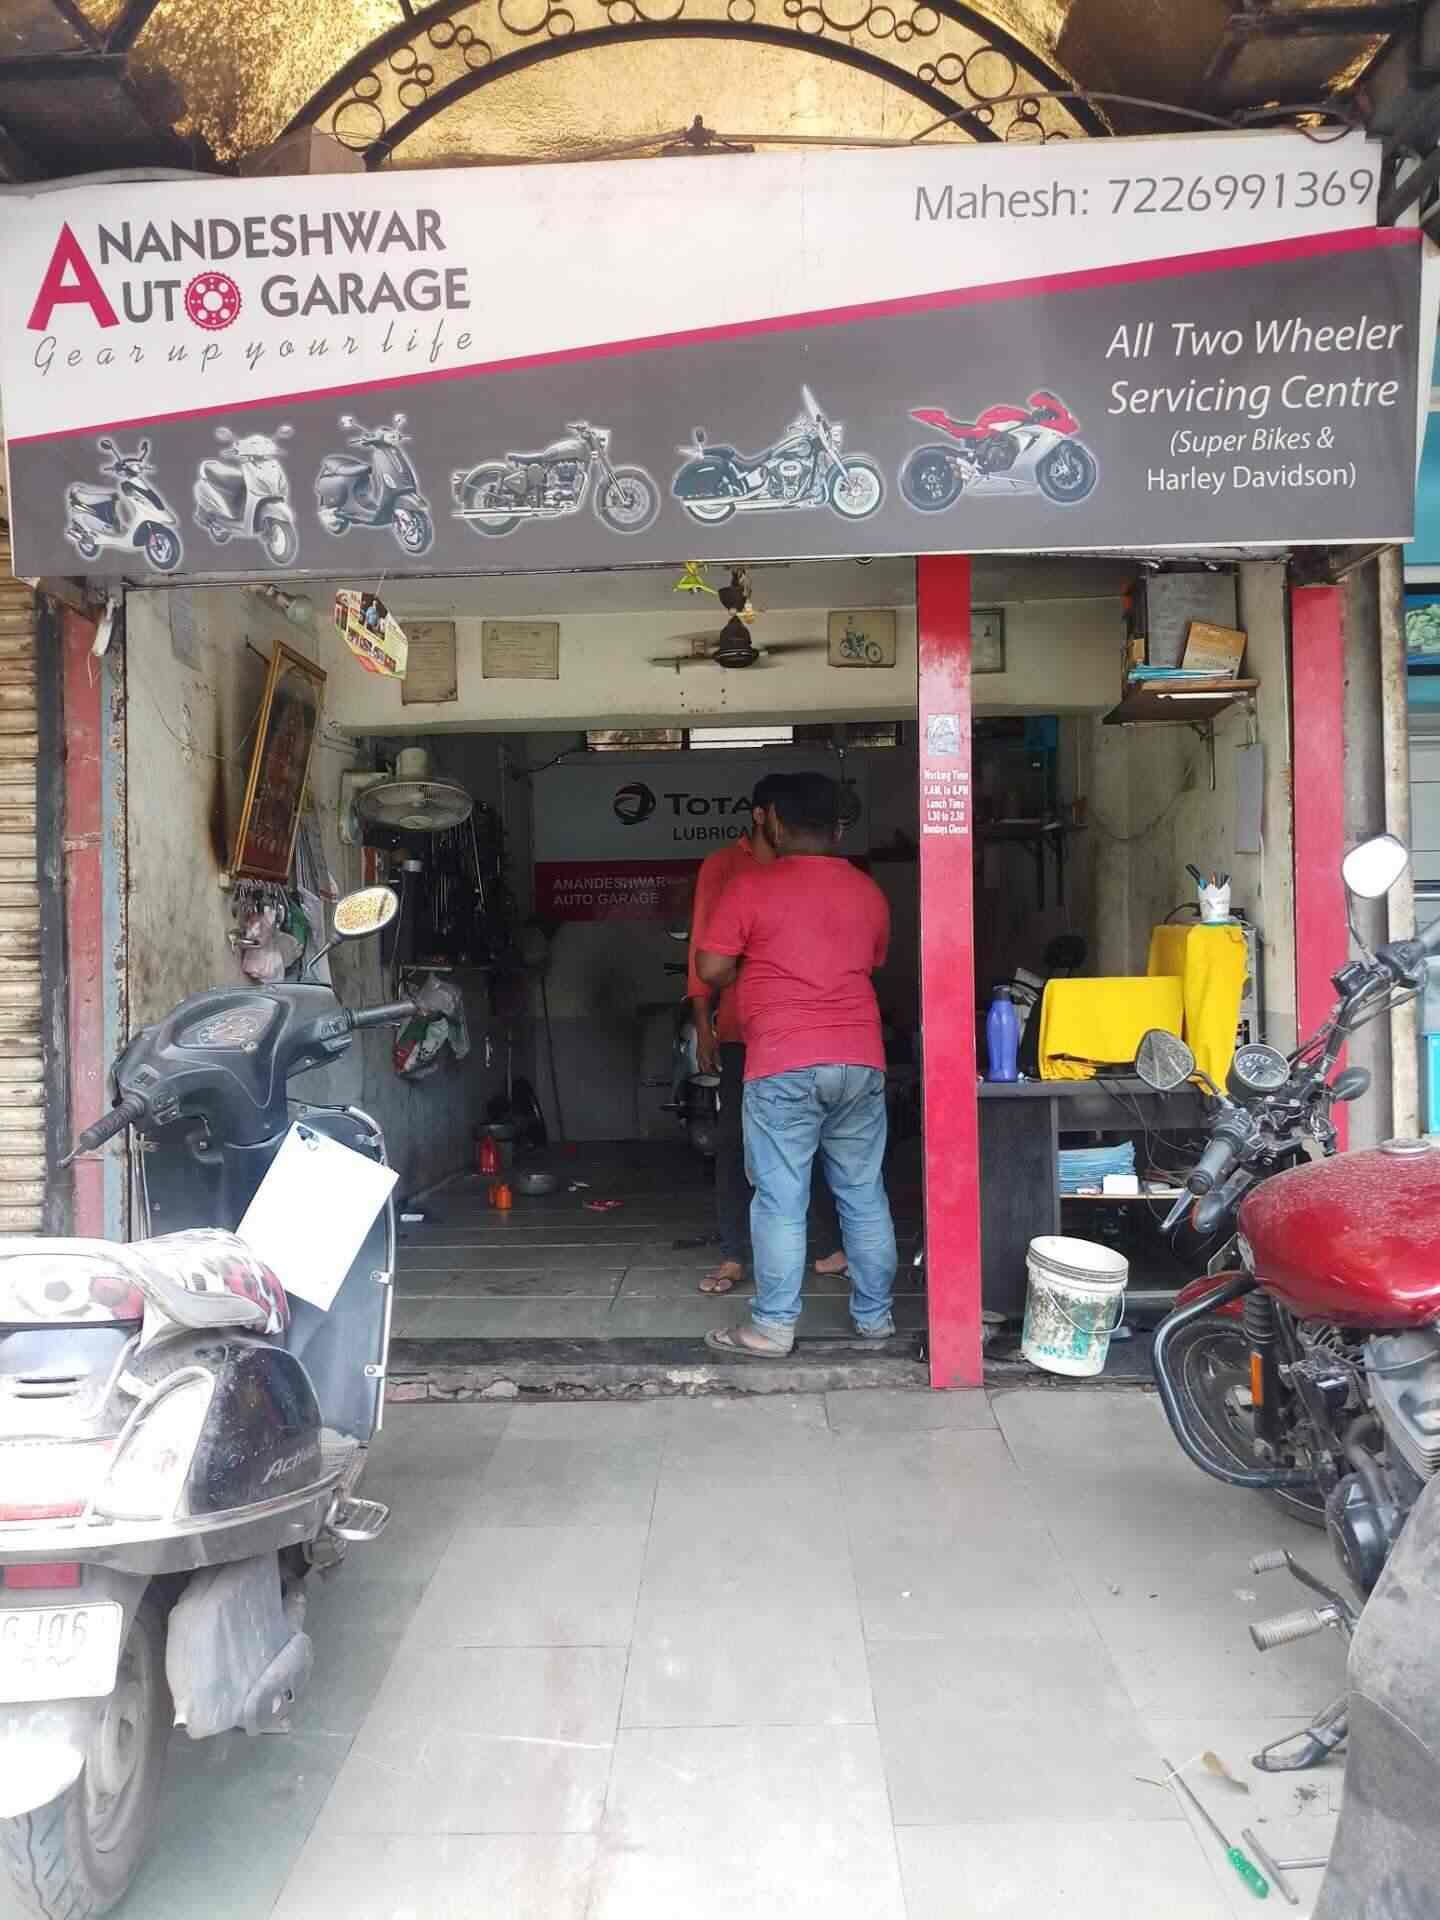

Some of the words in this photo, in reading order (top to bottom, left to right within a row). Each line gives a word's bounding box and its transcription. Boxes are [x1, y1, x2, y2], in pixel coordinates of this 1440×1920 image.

[914, 181, 1090, 222] Mahesh:
[1107, 168, 1375, 215] 7226991369
[27, 208, 447, 332] ANANDESHWAR
[260, 266, 472, 318] GARAGE
[33, 335, 145, 376] Gear
[167, 341, 224, 372] up
[245, 332, 360, 372] your
[380, 319, 474, 362] life
[1104, 321, 1153, 360] All
[1171, 321, 1243, 358] Two
[1254, 315, 1404, 354] Wheeler
[1107, 379, 1272, 419] Servicing
[1280, 375, 1400, 410] Centre
[1169, 429, 1247, 458] (Super
[1251, 427, 1312, 450] Bikes
[1316, 427, 1335, 448] &
[1146, 467, 1226, 496] Harley
[1232, 461, 1357, 489] Davidson)
[663, 793, 753, 816] TOTA
[672, 825, 751, 841] LUBRICA
[552, 876, 667, 890] ANANDESHWAR
[553, 894, 593, 906] AUTO
[597, 892, 661, 906] GARAGE
